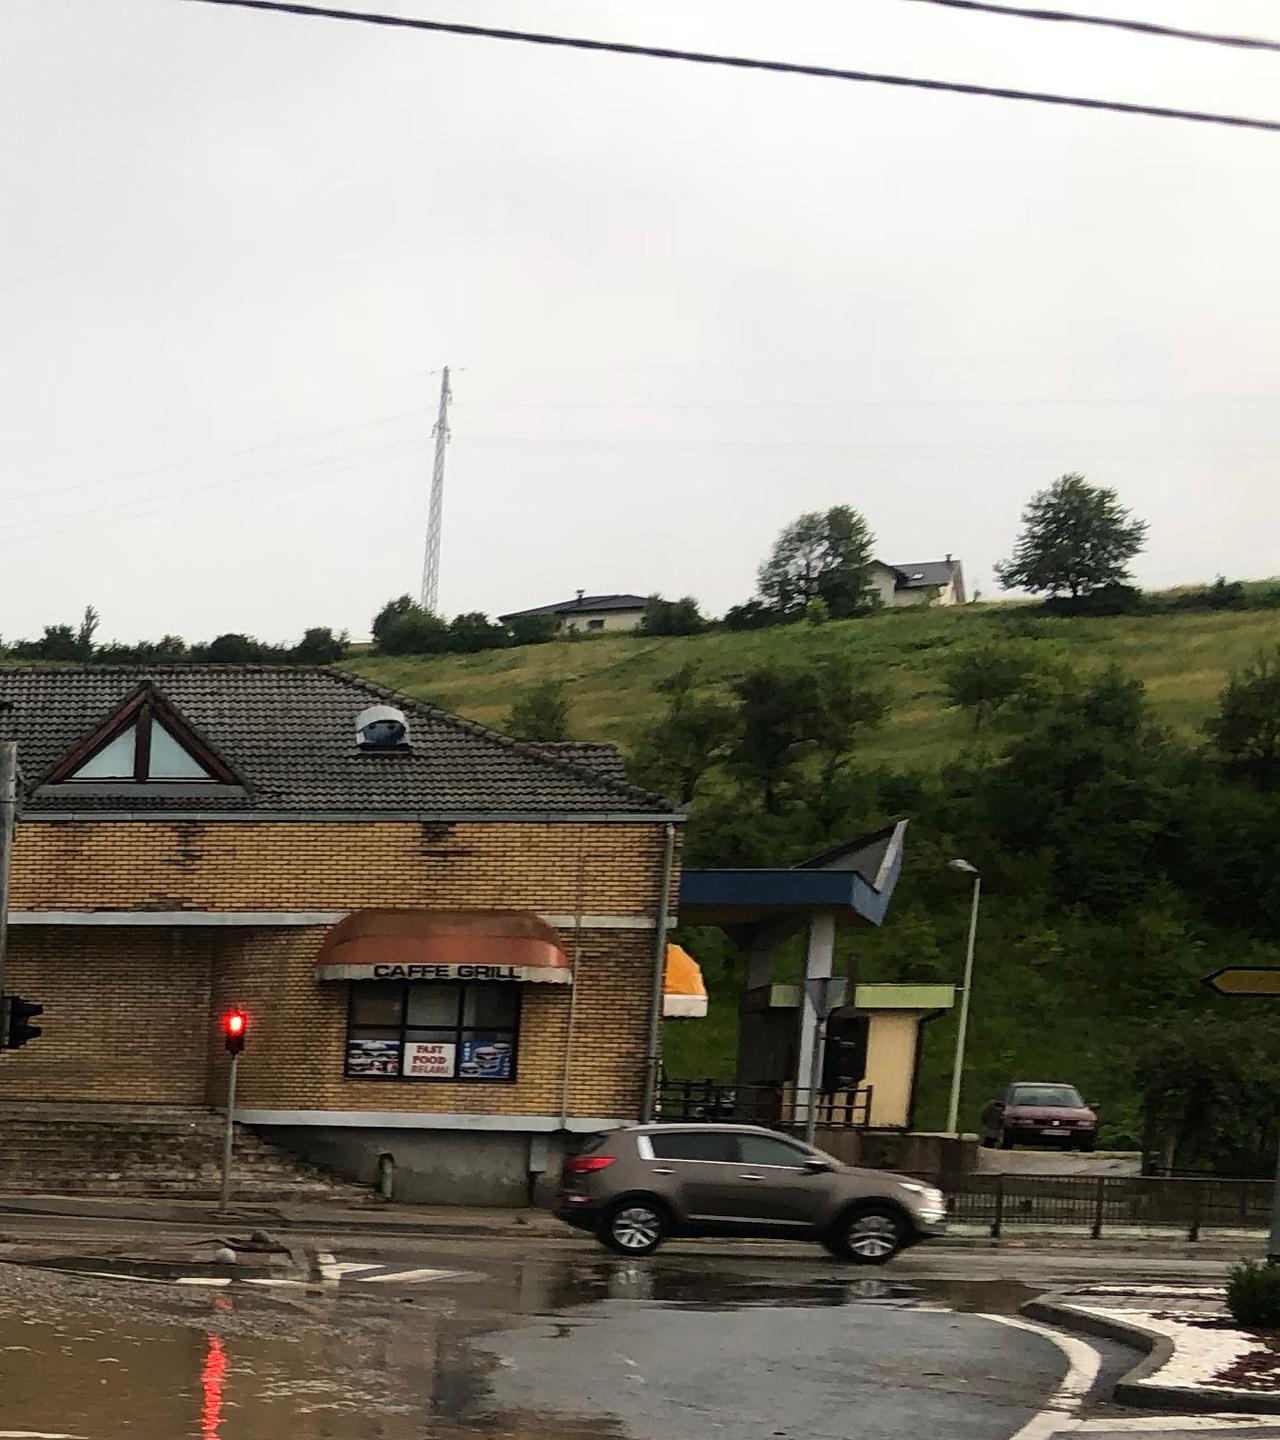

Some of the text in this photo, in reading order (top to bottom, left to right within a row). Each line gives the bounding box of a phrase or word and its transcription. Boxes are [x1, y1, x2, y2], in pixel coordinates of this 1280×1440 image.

[374, 964, 522, 980] CAFFE GRILL
[416, 1044, 444, 1054] FAST
[412, 1055, 446, 1065] FOOD
